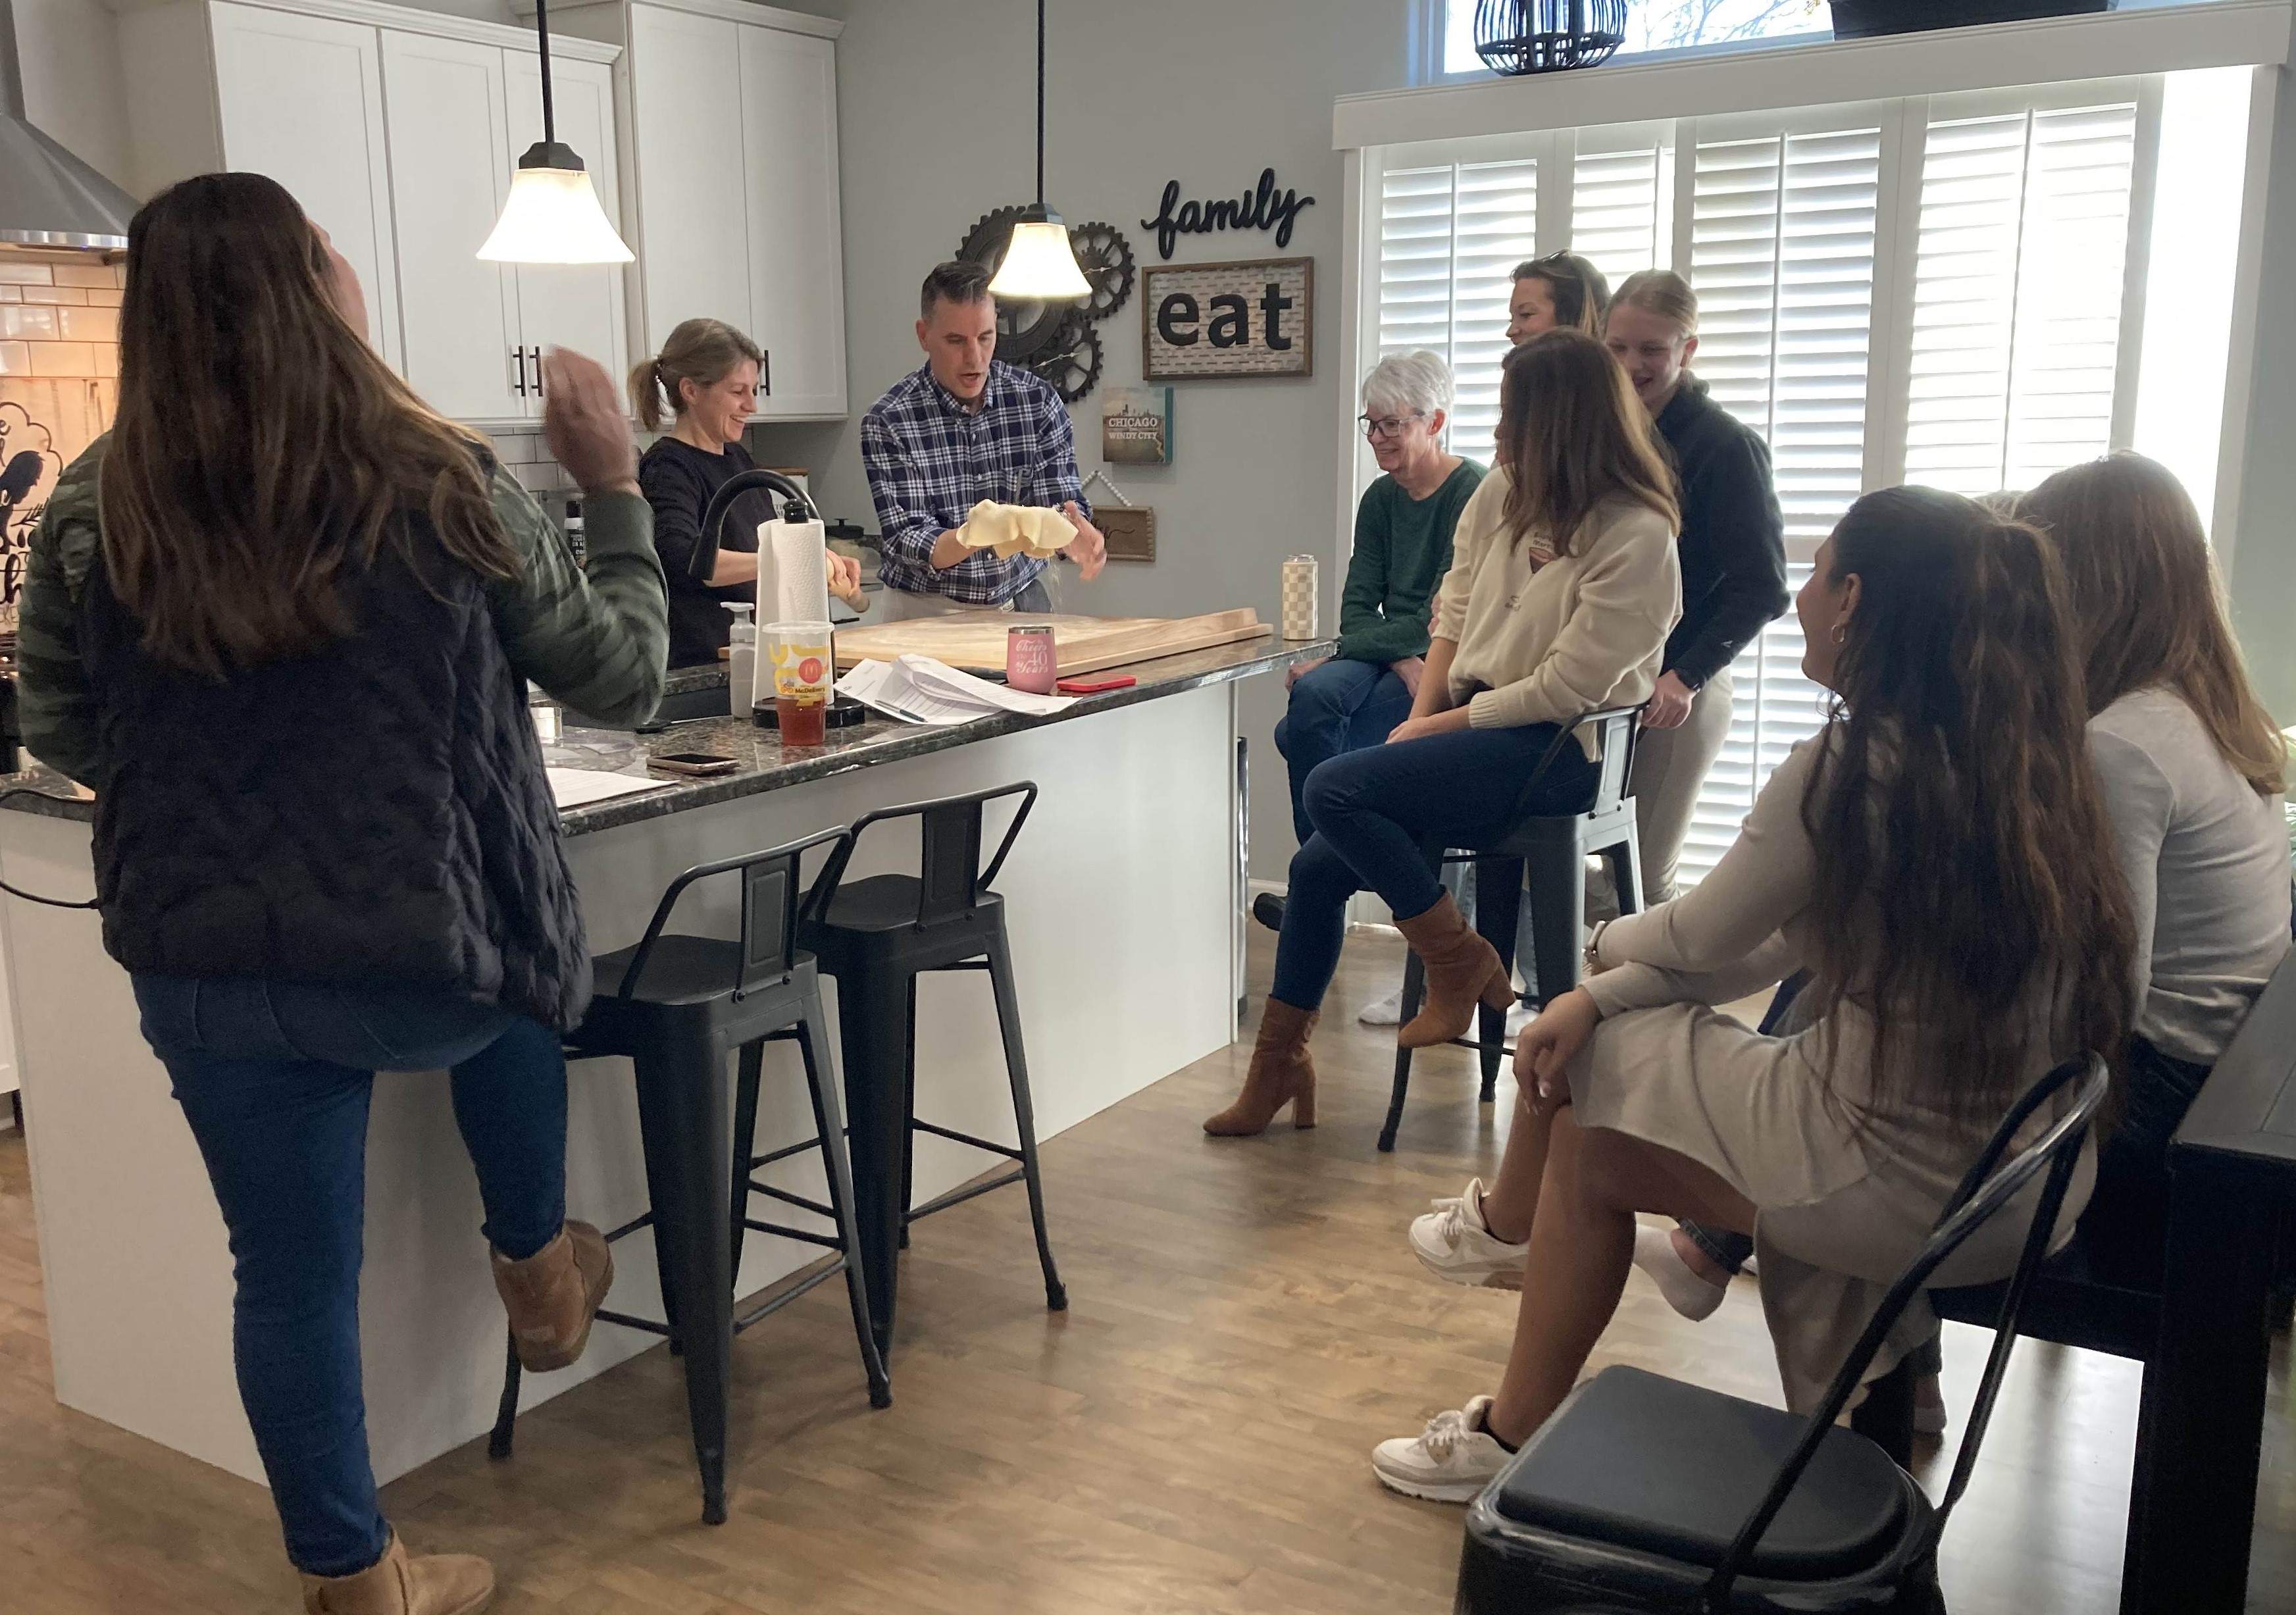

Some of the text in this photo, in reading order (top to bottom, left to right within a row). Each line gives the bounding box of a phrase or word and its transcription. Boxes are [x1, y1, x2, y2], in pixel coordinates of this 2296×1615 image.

[1140, 168, 1315, 259] family
[1157, 284, 1292, 351] eat
[1108, 417, 1158, 427] CHICAGO
[1028, 650, 1048, 665] 40
